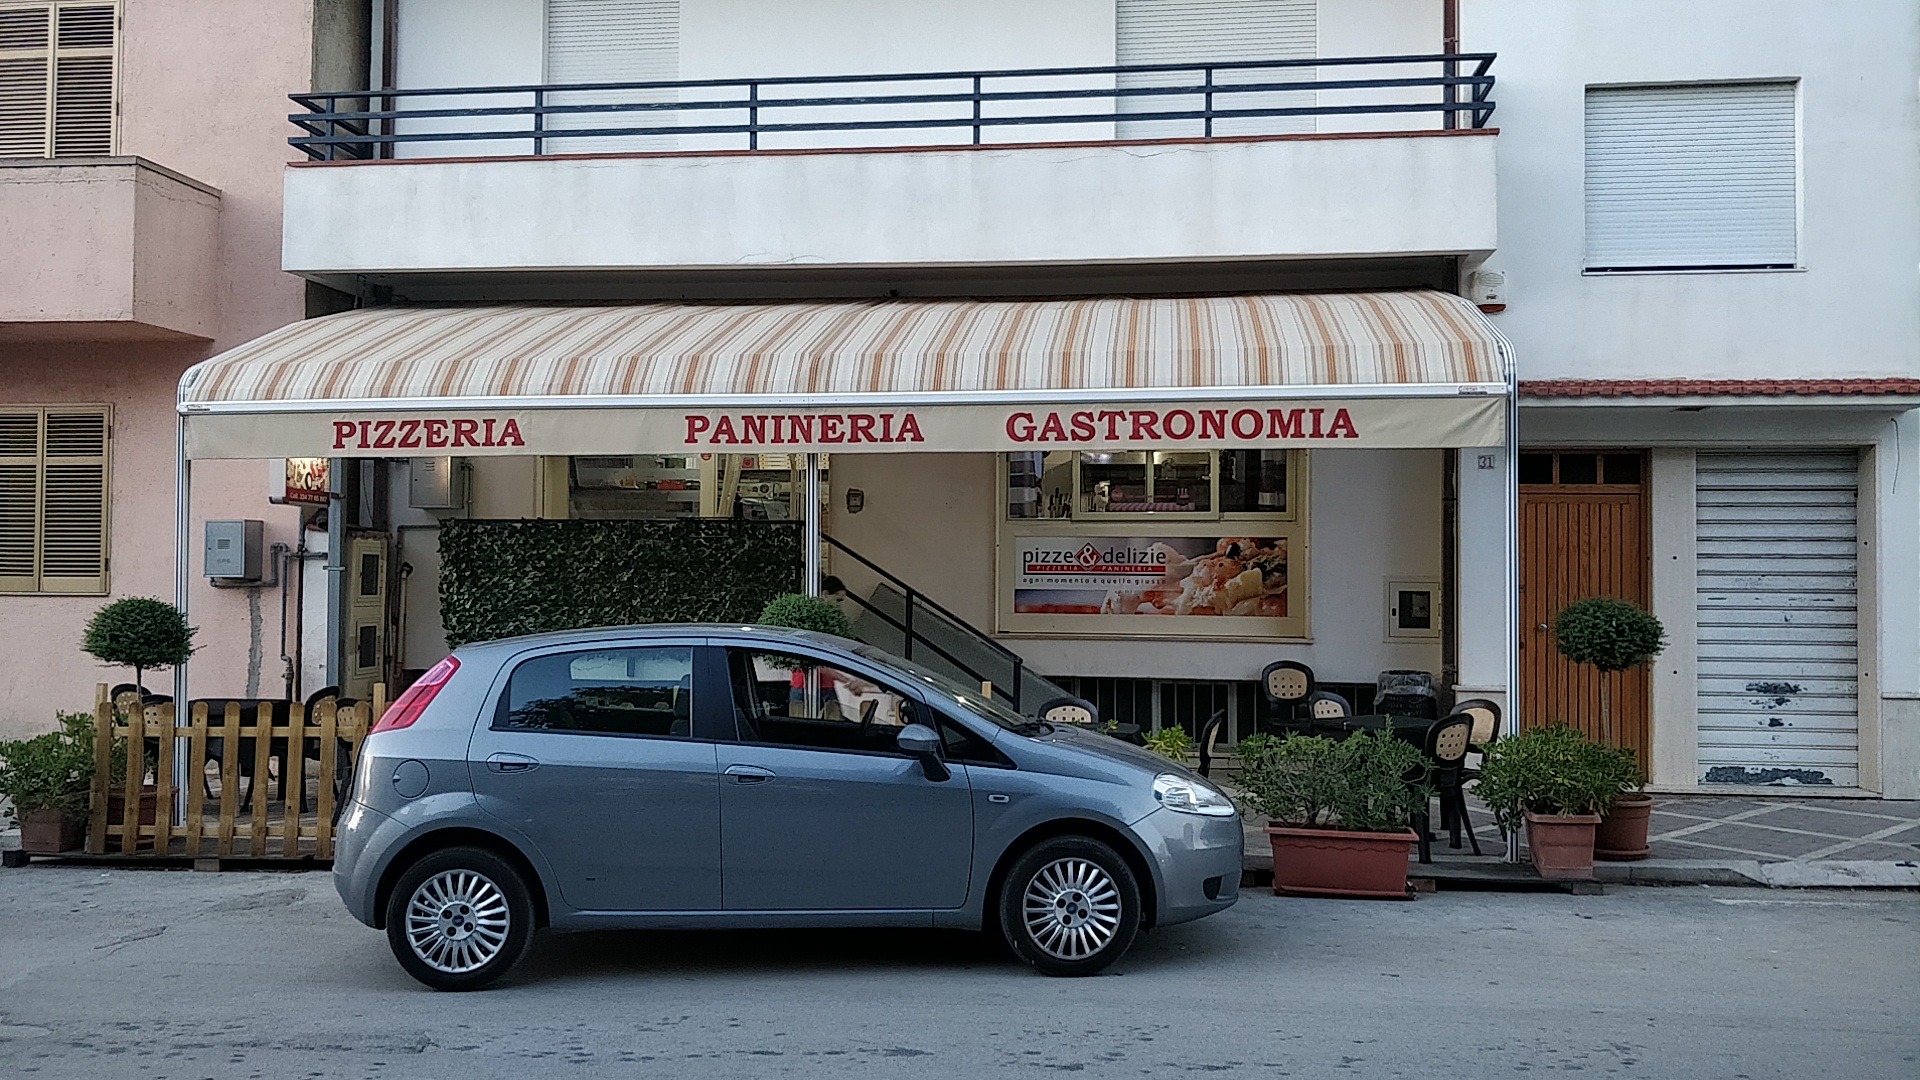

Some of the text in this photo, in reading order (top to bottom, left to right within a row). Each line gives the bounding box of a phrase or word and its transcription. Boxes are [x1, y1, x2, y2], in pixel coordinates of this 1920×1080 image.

[333, 418, 525, 450] PIZZERIA
[685, 412, 925, 445] PANINERIA
[1005, 408, 1359, 442] GASTRONOMIA
[1478, 454, 1494, 470] 31
[1023, 547, 1074, 570] pizze
[1102, 547, 1167, 564] delizie
[1100, 578, 1132, 586] quello
